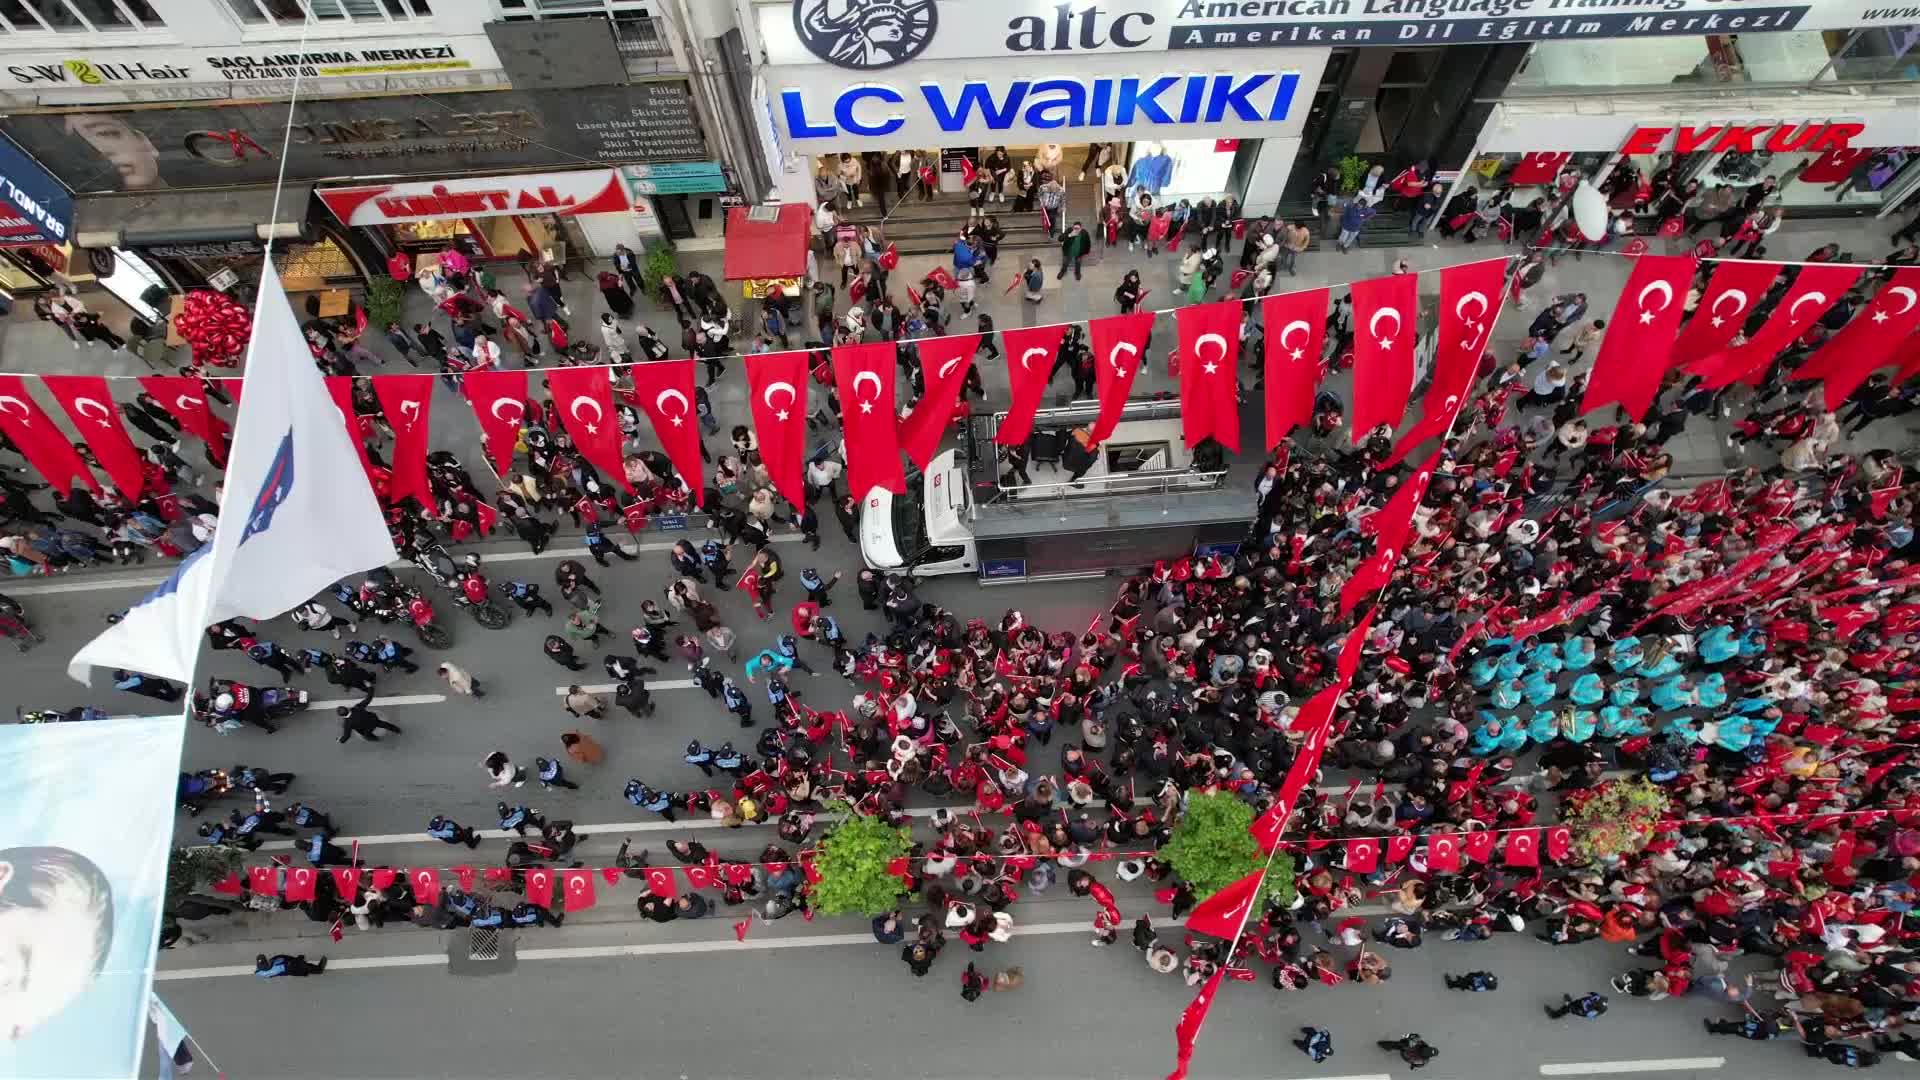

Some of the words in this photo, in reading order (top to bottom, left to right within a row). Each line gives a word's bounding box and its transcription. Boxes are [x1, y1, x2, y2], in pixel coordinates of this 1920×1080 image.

[1176, 0, 1349, 18] American
[1005, 2, 1155, 51] altc
[1184, 26, 1372, 44] Amerikan
[1398, 23, 1454, 39] Dil
[362, 45, 456, 62] MERKEZİ
[119, 63, 193, 80] Hair
[649, 86, 682, 96] Filler
[648, 98, 687, 106] Botox
[631, 109, 659, 117] Skin
[661, 107, 689, 117] Care
[781, 84, 906, 138] LC
[576, 122, 608, 130] Laser
[610, 120, 637, 128] Hair
[640, 118, 692, 128] Removal
[600, 131, 625, 139] Hair
[629, 128, 697, 137] Treatments
[1619, 122, 1866, 155] EVKUR
[603, 140, 630, 149] Skin
[632, 137, 700, 147] Treatments
[597, 149, 646, 158] Medical
